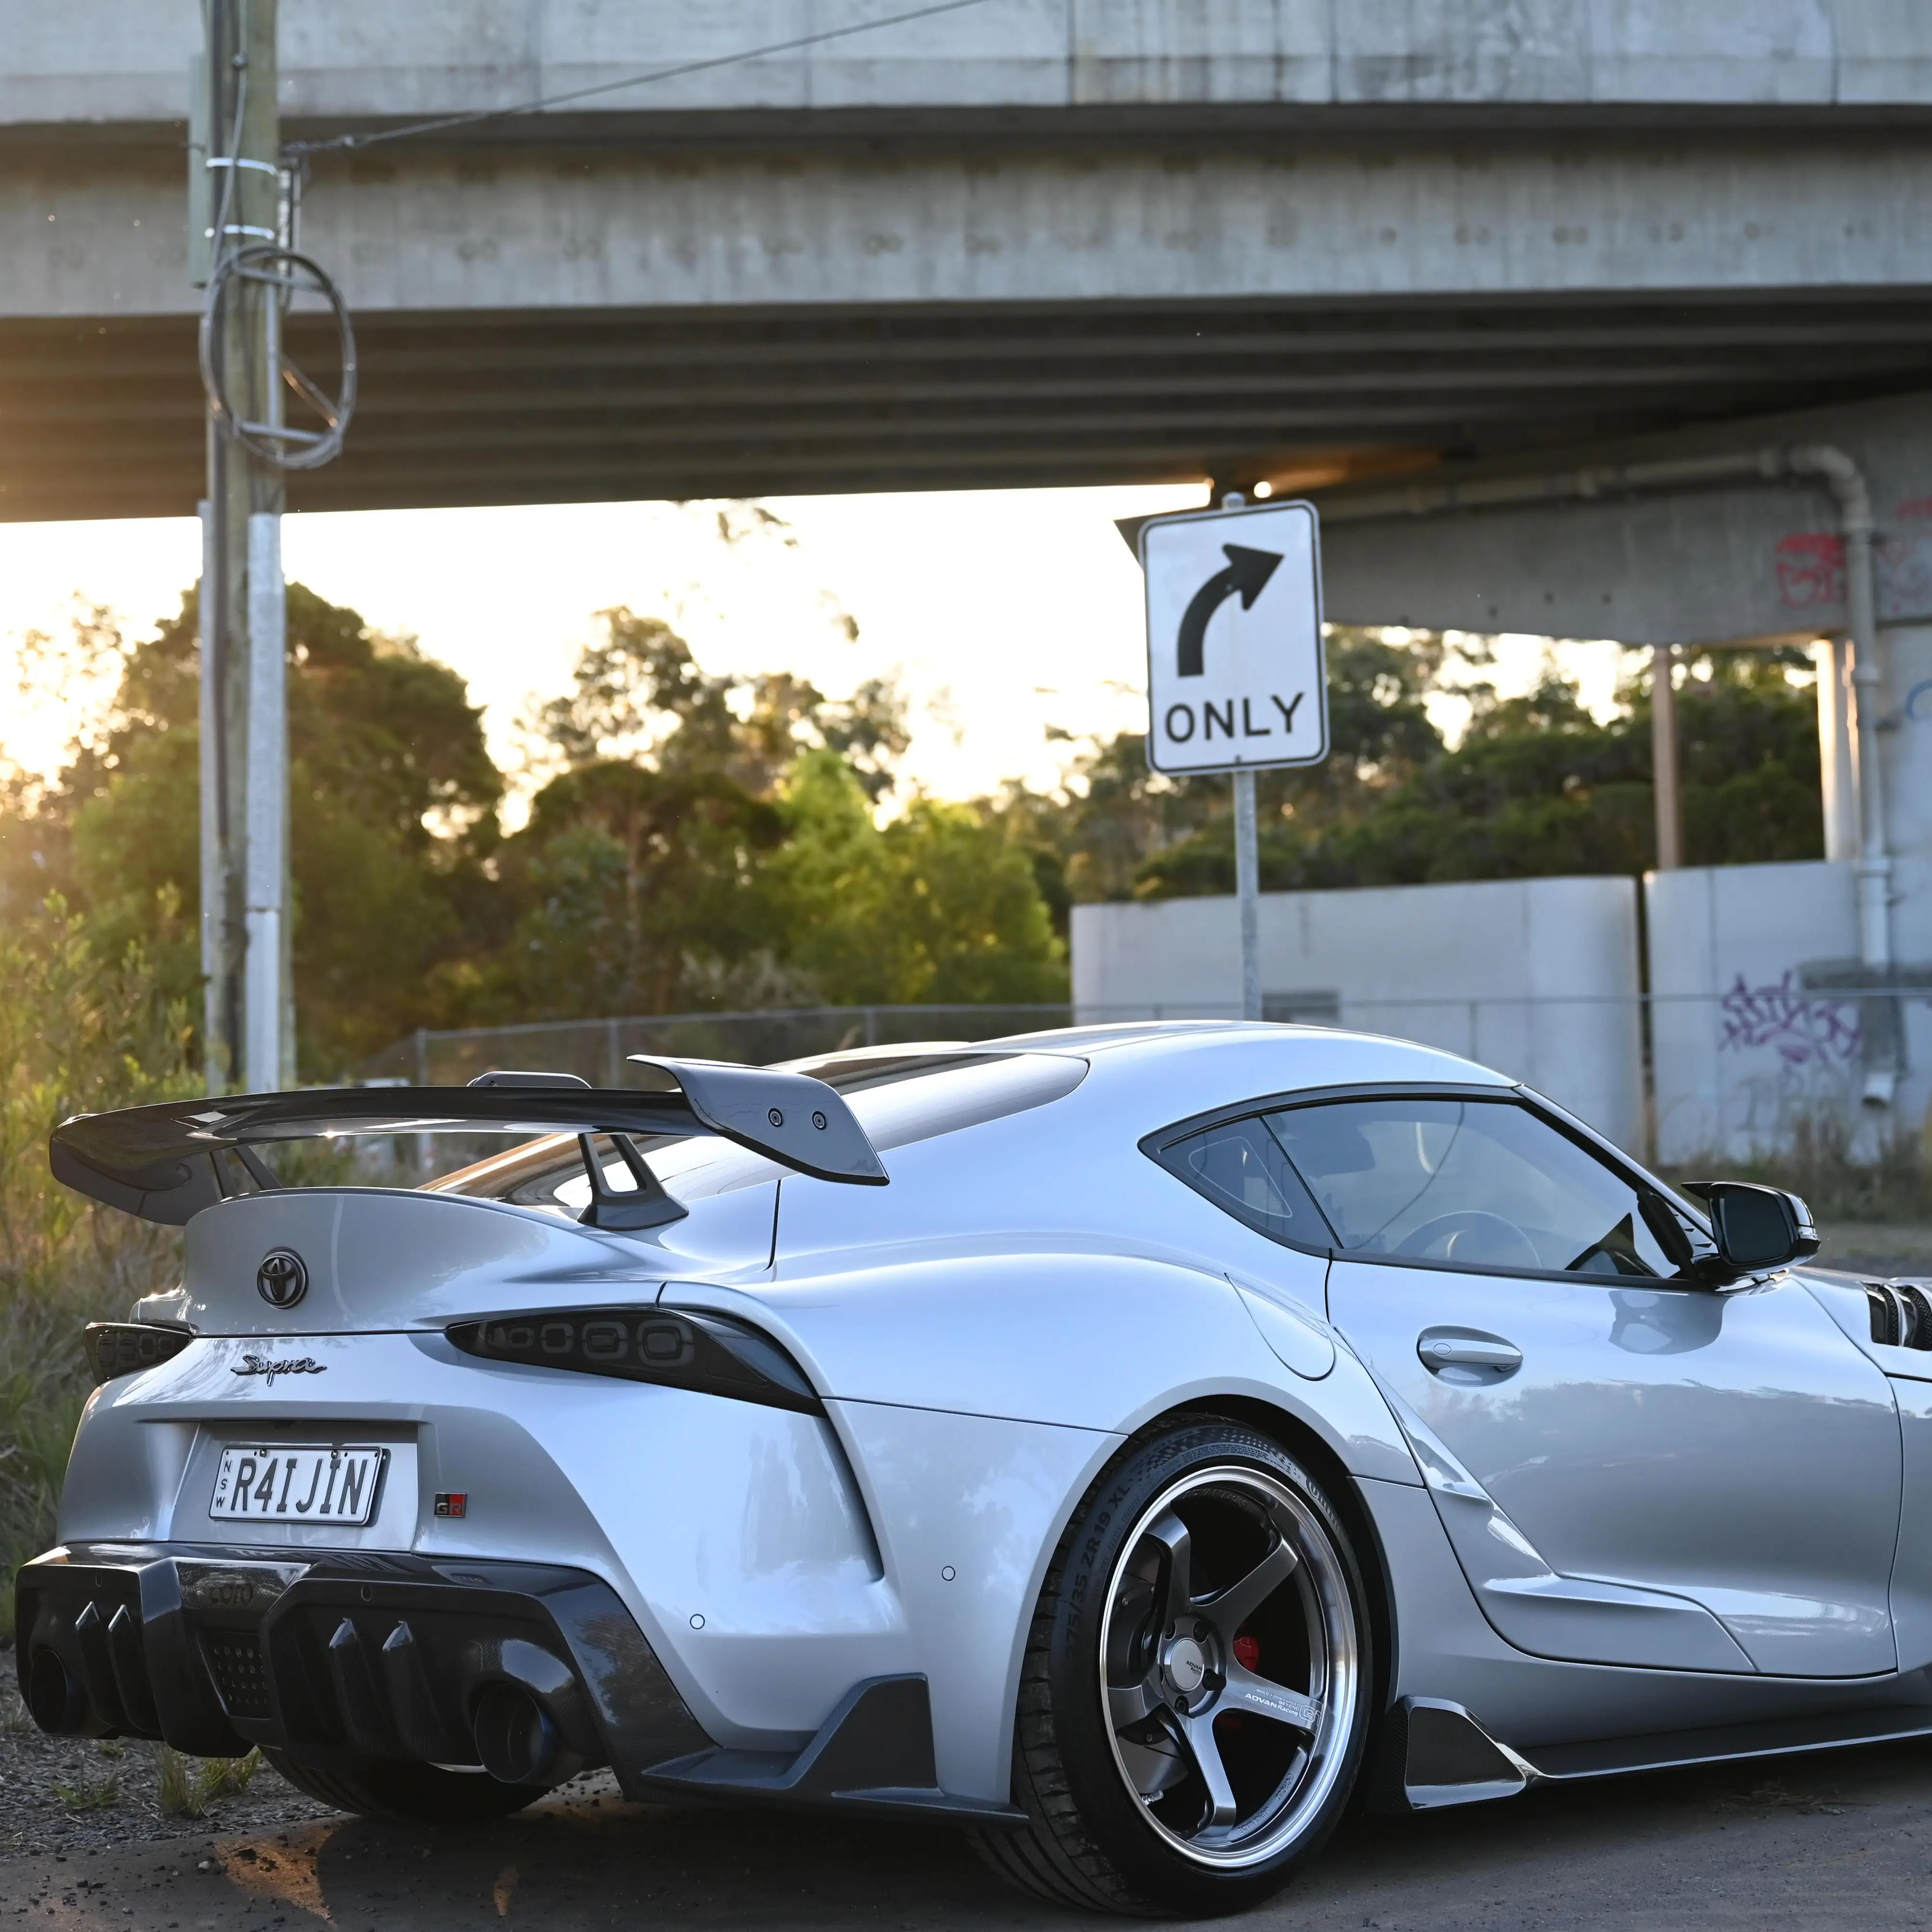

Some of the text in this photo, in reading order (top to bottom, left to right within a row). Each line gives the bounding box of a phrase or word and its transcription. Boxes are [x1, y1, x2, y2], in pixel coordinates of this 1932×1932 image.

[1164, 692, 1304, 744] ONLY
[230, 1353, 328, 1387] Supra
[230, 1458, 369, 1514] R4IJIN
[436, 1502, 462, 1515] GR
[1080, 1537, 1100, 1569] ZR
[1094, 1511, 1111, 1534] 19
[1107, 1485, 1131, 1509] XL
[1244, 1693, 1278, 1709] ADVAN
[1277, 1704, 1298, 1716] Racing
